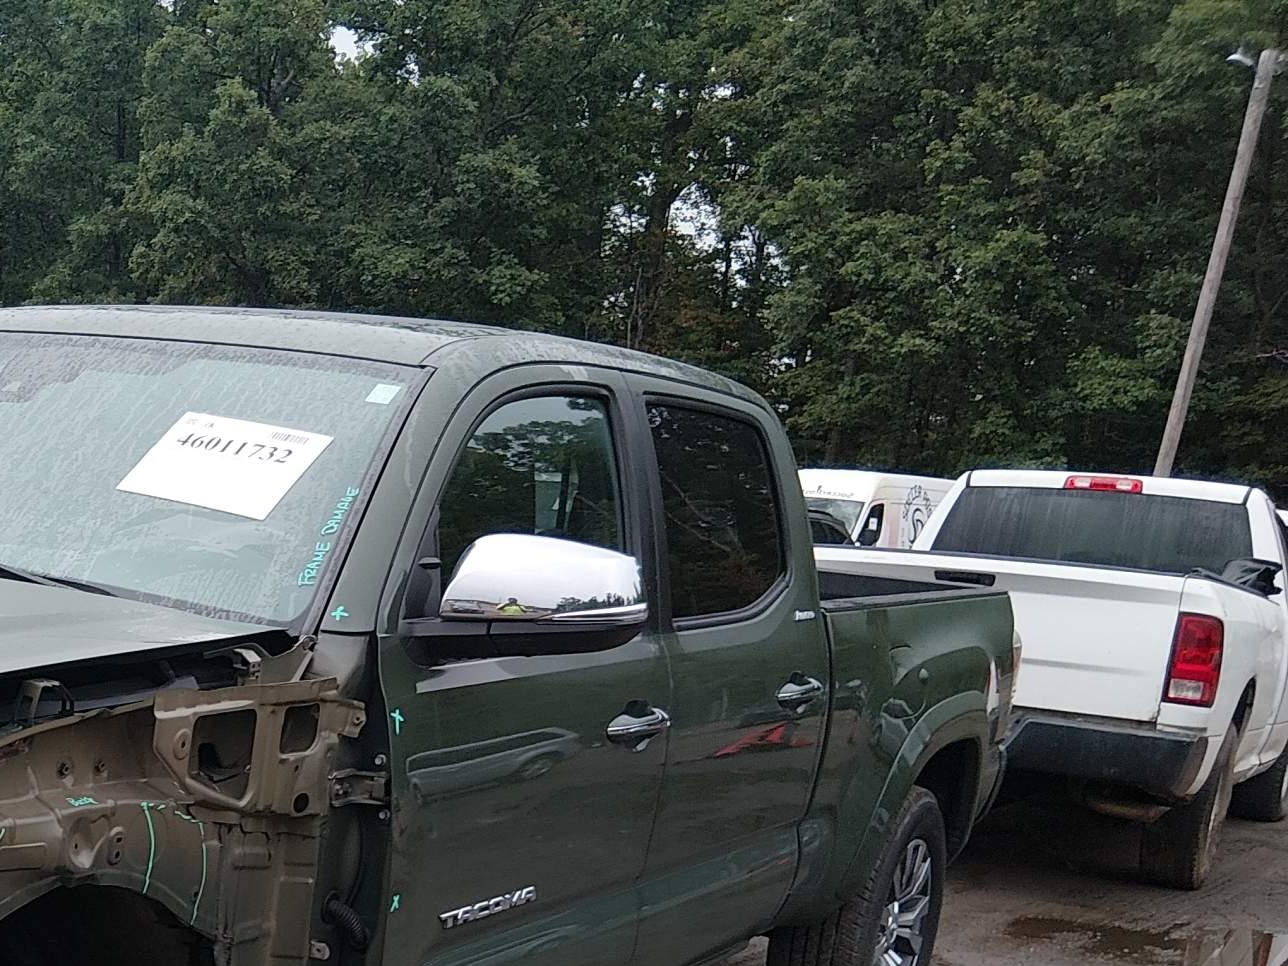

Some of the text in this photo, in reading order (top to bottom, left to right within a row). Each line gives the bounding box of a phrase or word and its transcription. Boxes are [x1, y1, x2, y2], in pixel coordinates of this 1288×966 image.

[177, 433, 293, 464] 46011732
[297, 541, 330, 587] FRAME
[438, 885, 537, 929] TACOMA
